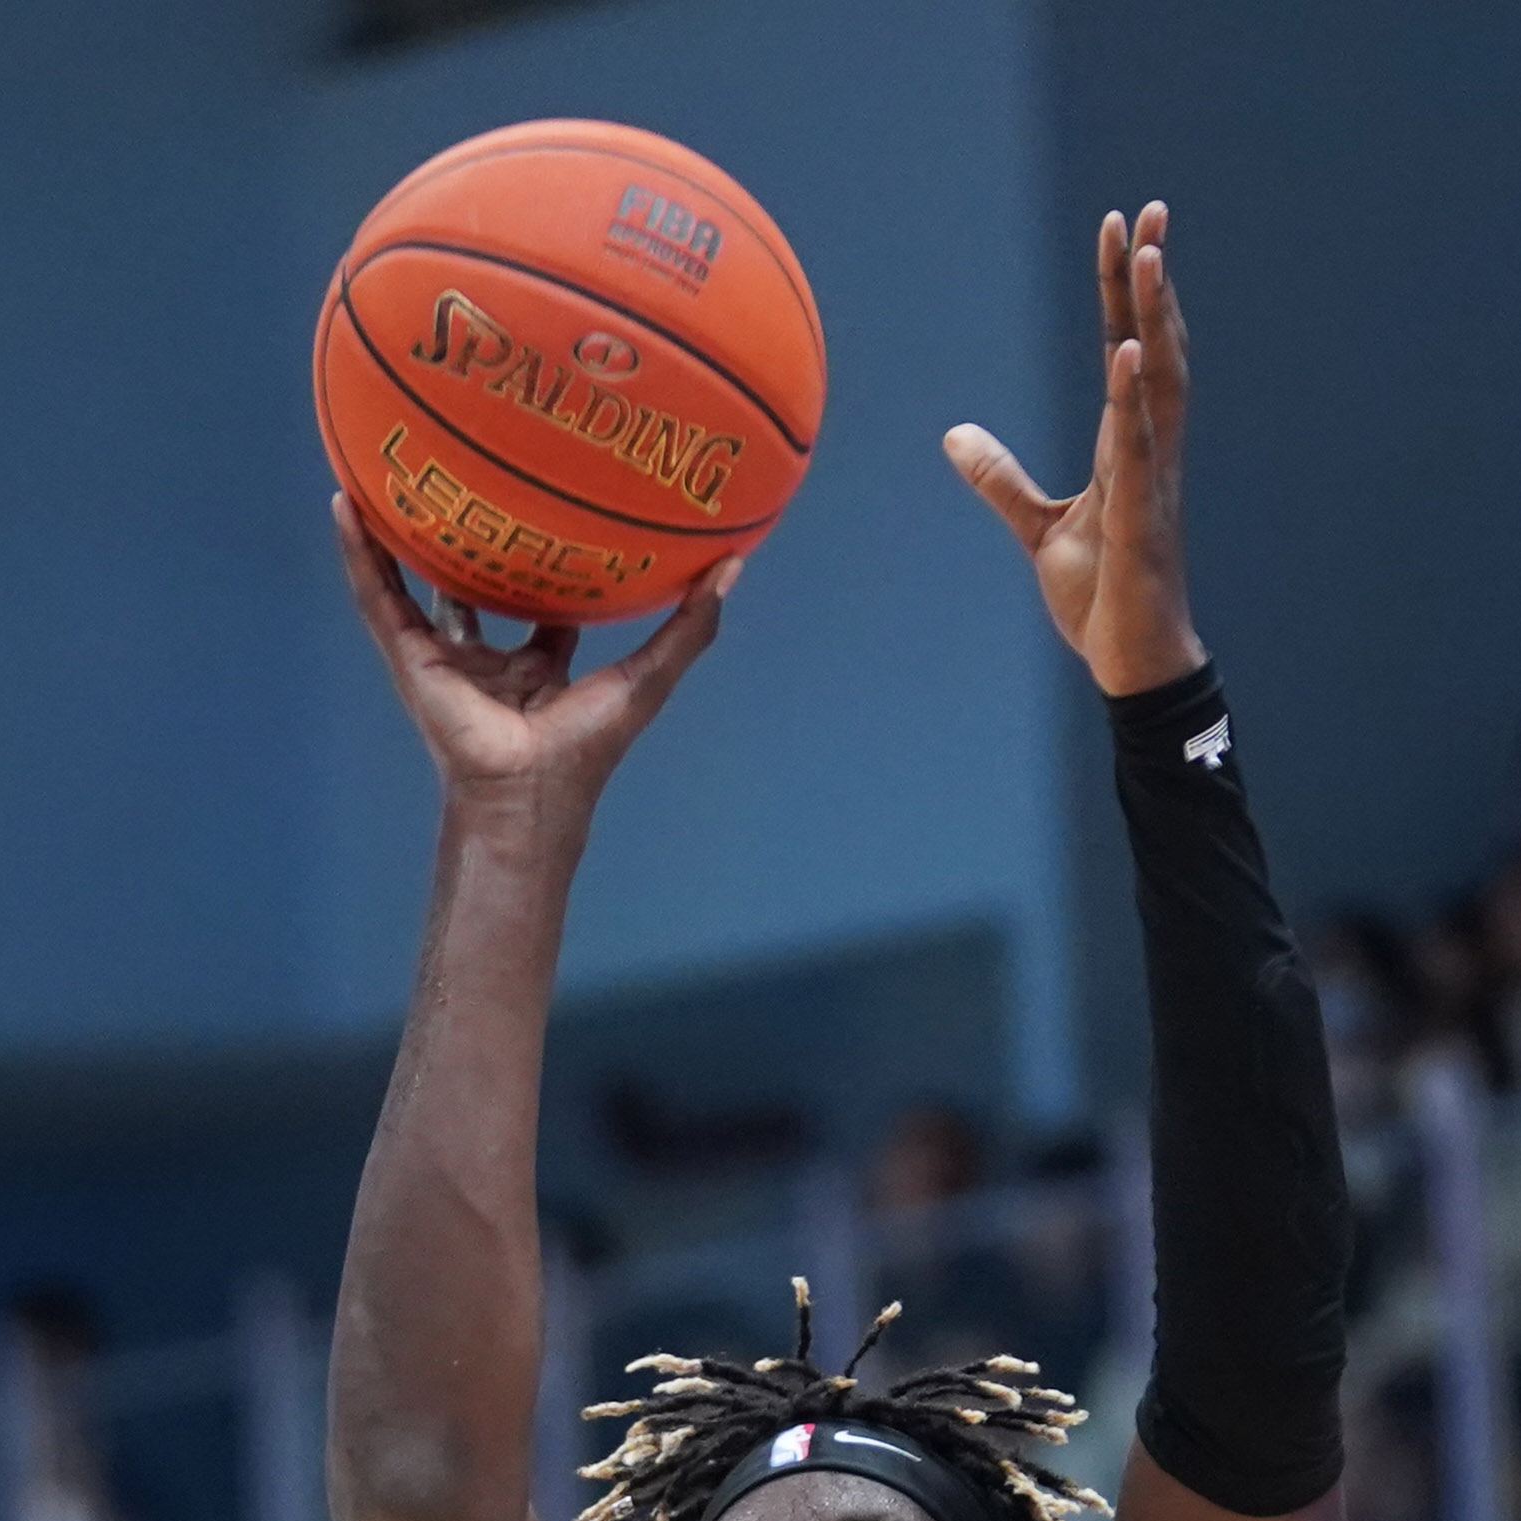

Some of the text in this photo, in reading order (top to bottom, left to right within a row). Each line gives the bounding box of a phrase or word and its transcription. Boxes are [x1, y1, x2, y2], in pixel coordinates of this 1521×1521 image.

[617, 184, 722, 263] FIBA
[410, 288, 747, 516] SPALDING
[380, 419, 657, 584] LEGACY
